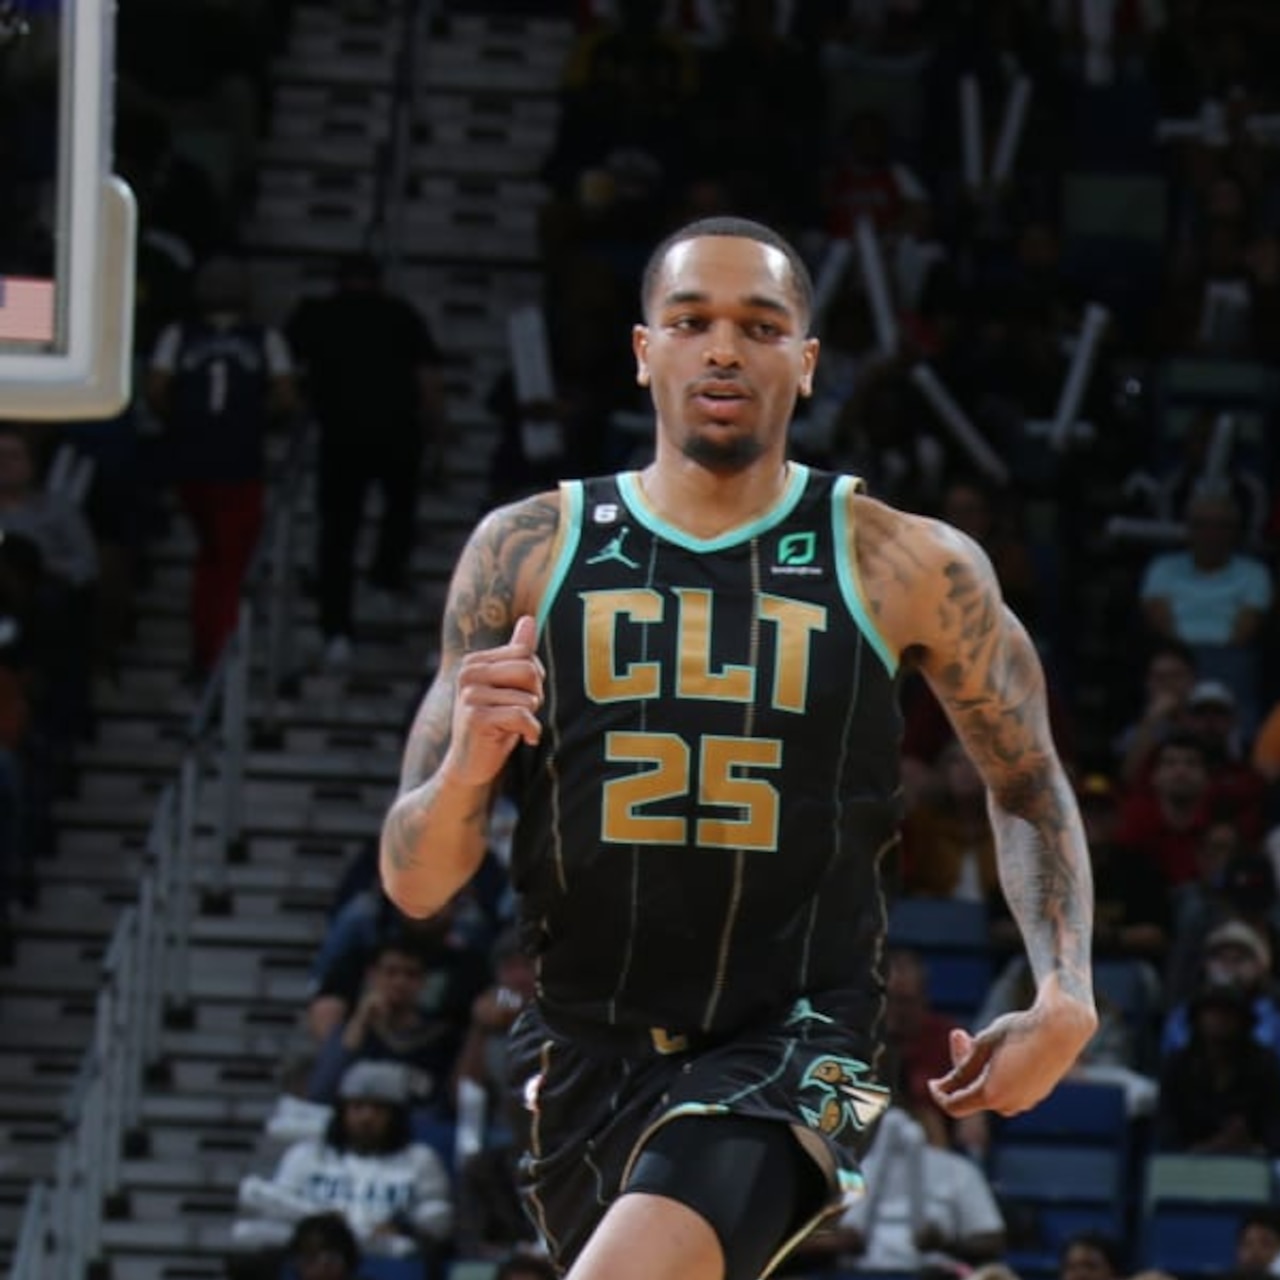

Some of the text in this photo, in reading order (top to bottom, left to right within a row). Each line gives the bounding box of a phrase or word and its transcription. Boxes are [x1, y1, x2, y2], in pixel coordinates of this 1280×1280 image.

[593, 504, 617, 523] 6
[578, 587, 828, 714] CLT
[601, 730, 782, 852] 25
